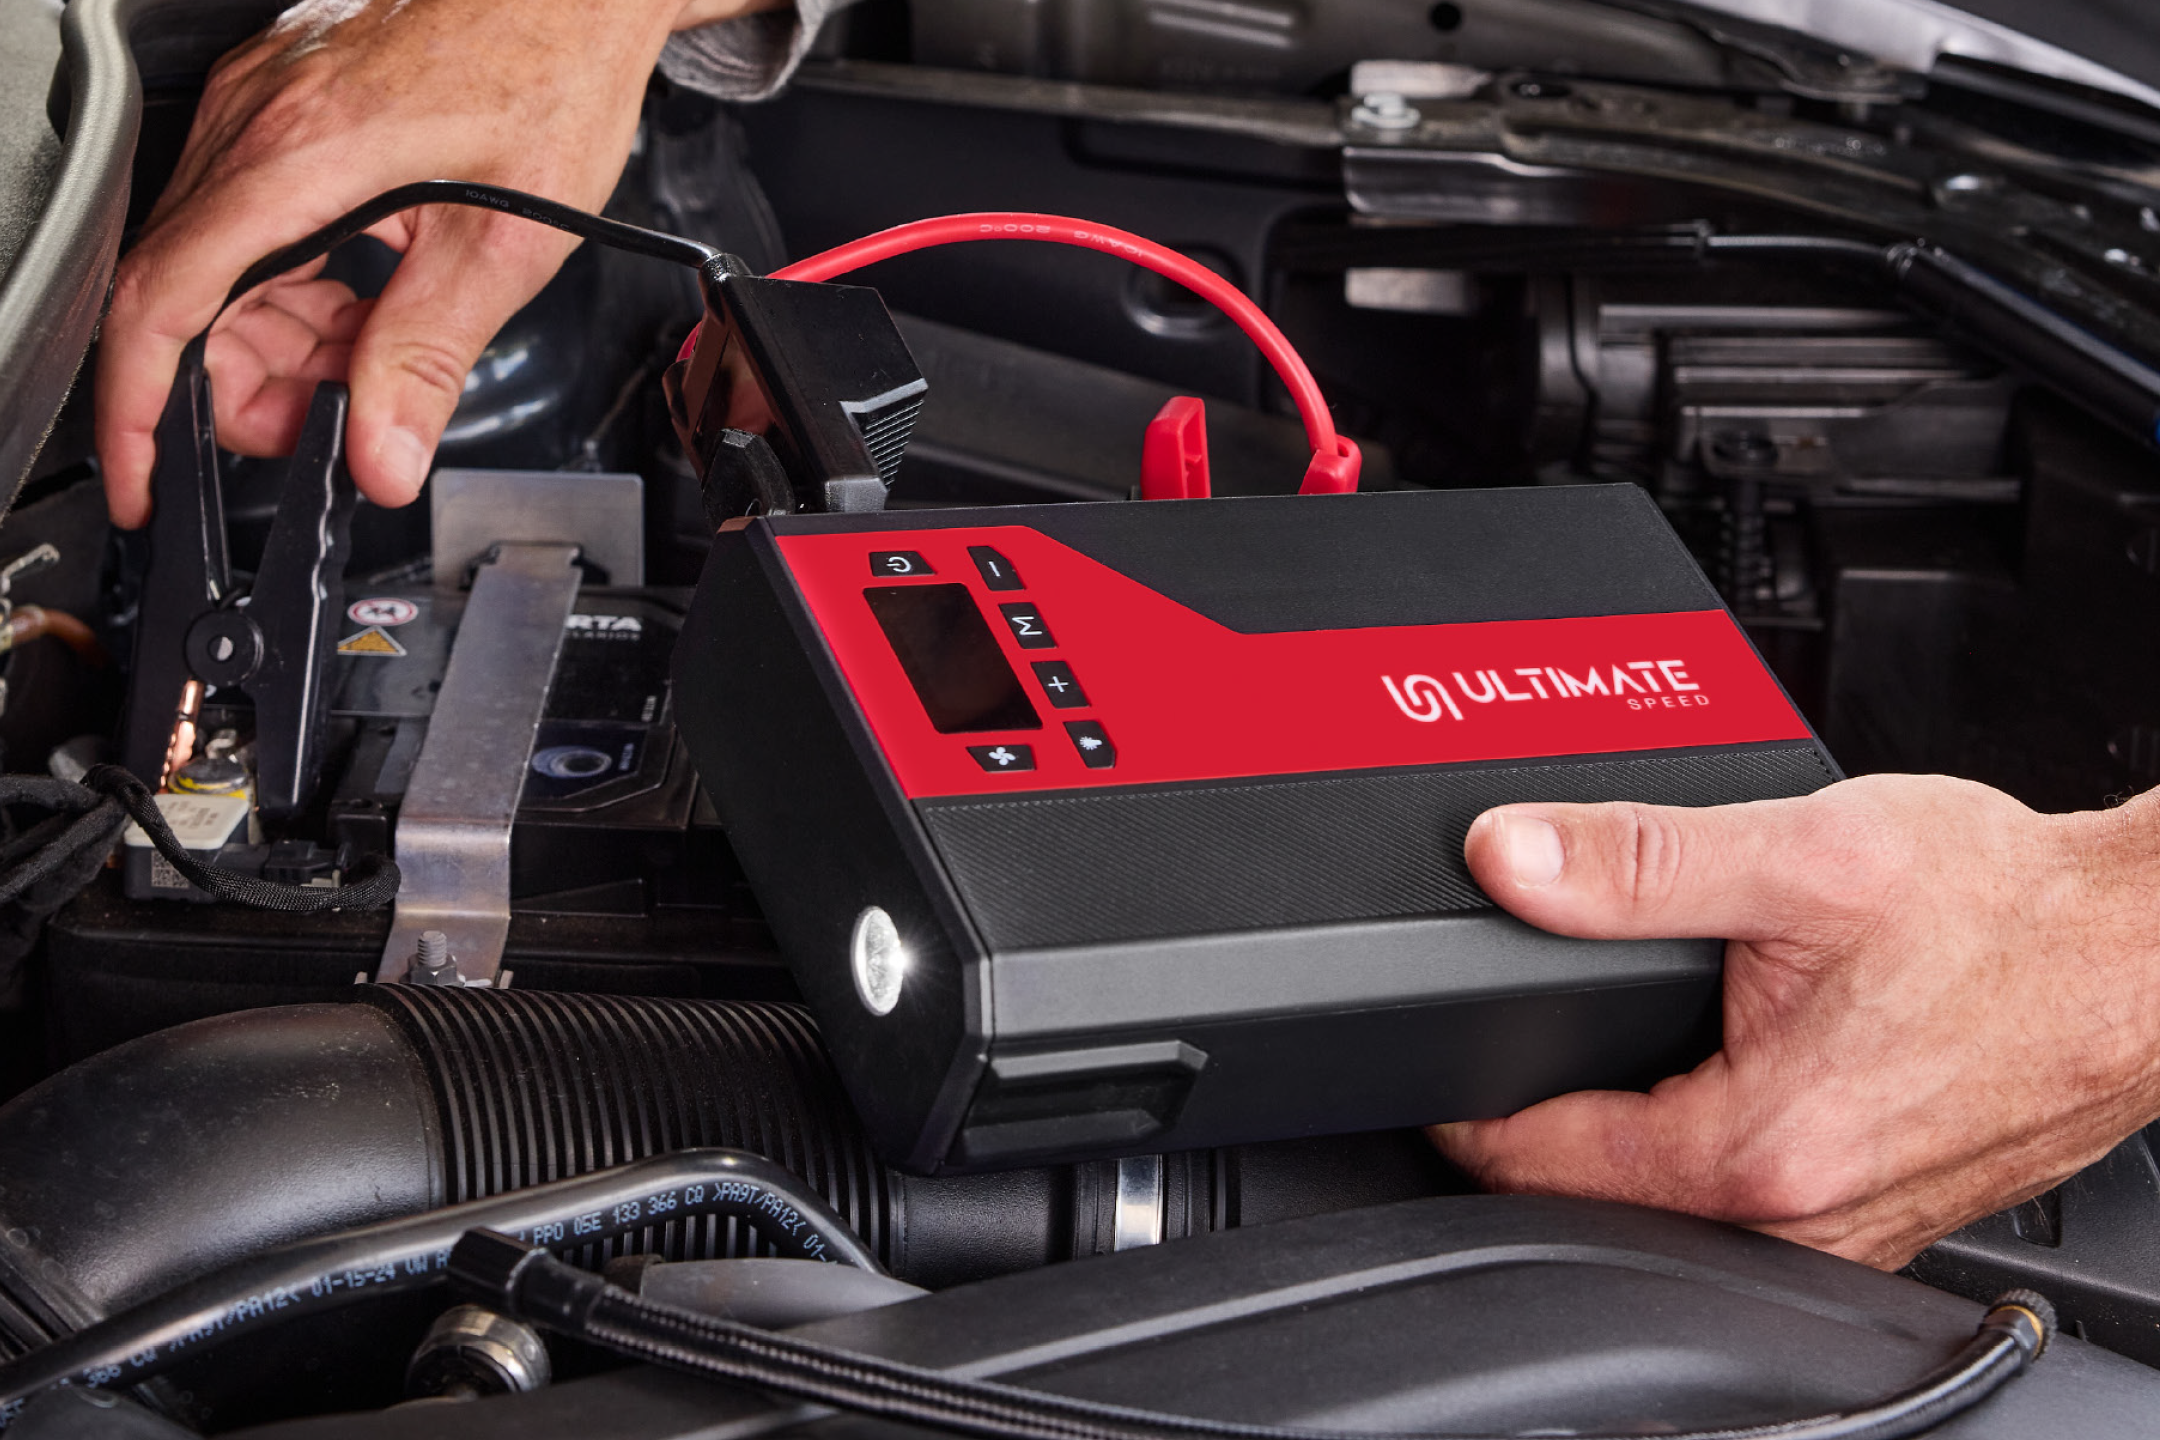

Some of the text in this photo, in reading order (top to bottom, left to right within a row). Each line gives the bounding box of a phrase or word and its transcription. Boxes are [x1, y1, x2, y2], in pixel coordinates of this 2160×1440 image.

[465, 189, 509, 208] 10AWG
[1451, 660, 1700, 703] ULTIMATE
[1627, 695, 1710, 711] SPEED
[612, 1202, 641, 1224] 133
[648, 1191, 678, 1214] 366
[803, 1233, 838, 1264] 01-
